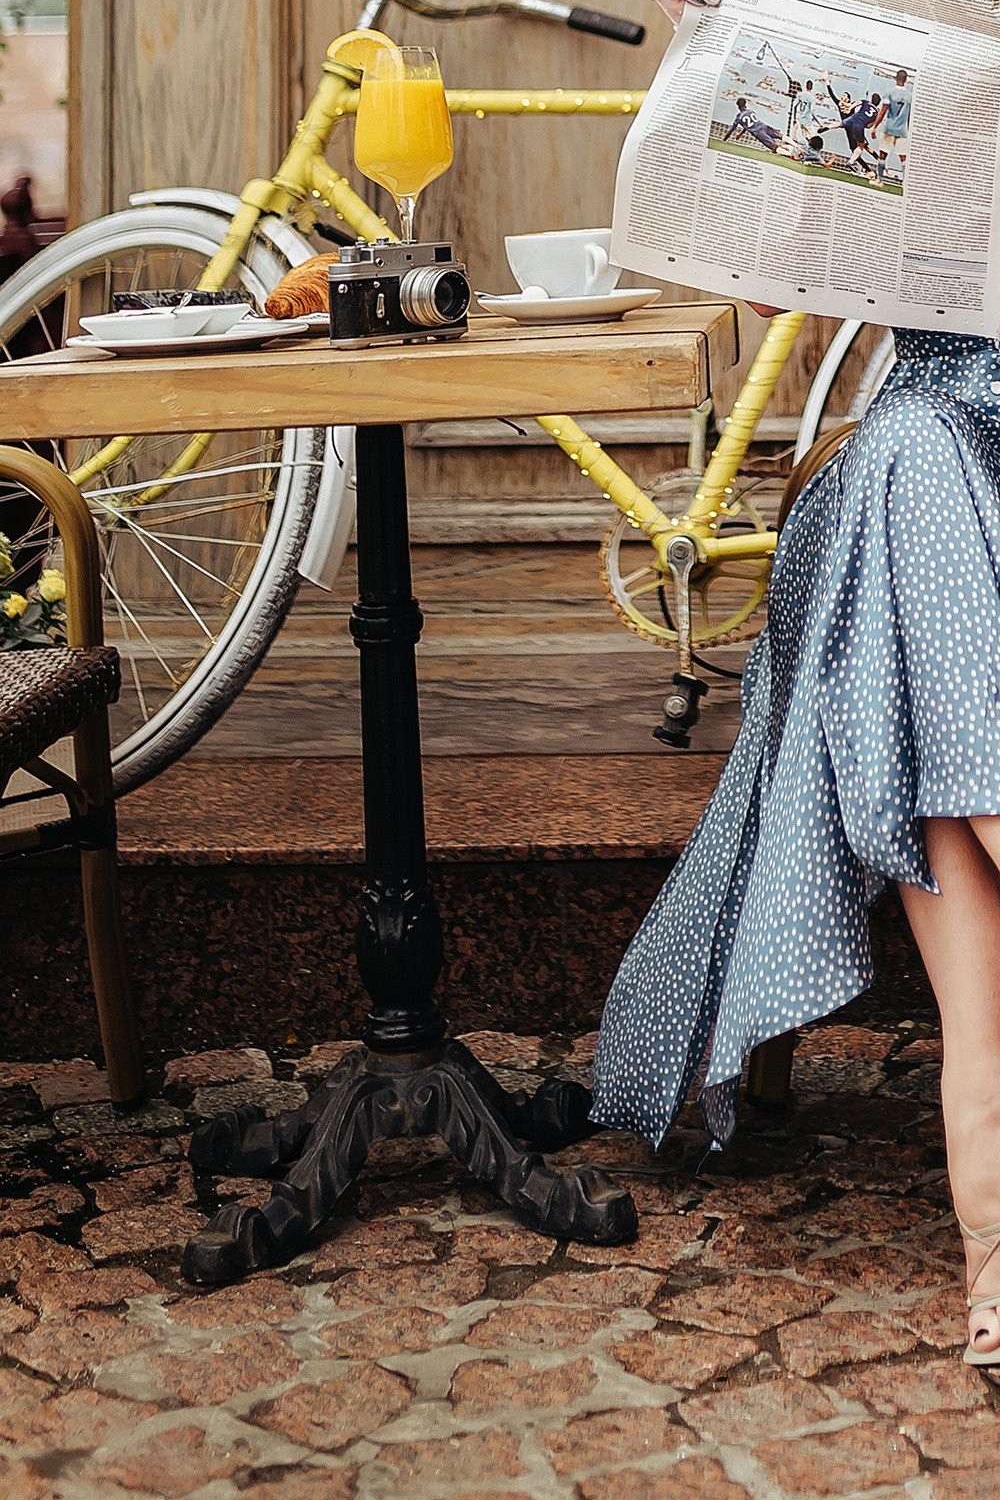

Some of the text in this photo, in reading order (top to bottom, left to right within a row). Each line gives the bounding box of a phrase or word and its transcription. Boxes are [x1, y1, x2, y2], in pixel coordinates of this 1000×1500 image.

[865, 105, 876, 118] 3
[895, 101, 905, 116] 7
[742, 112, 759, 128] 20
